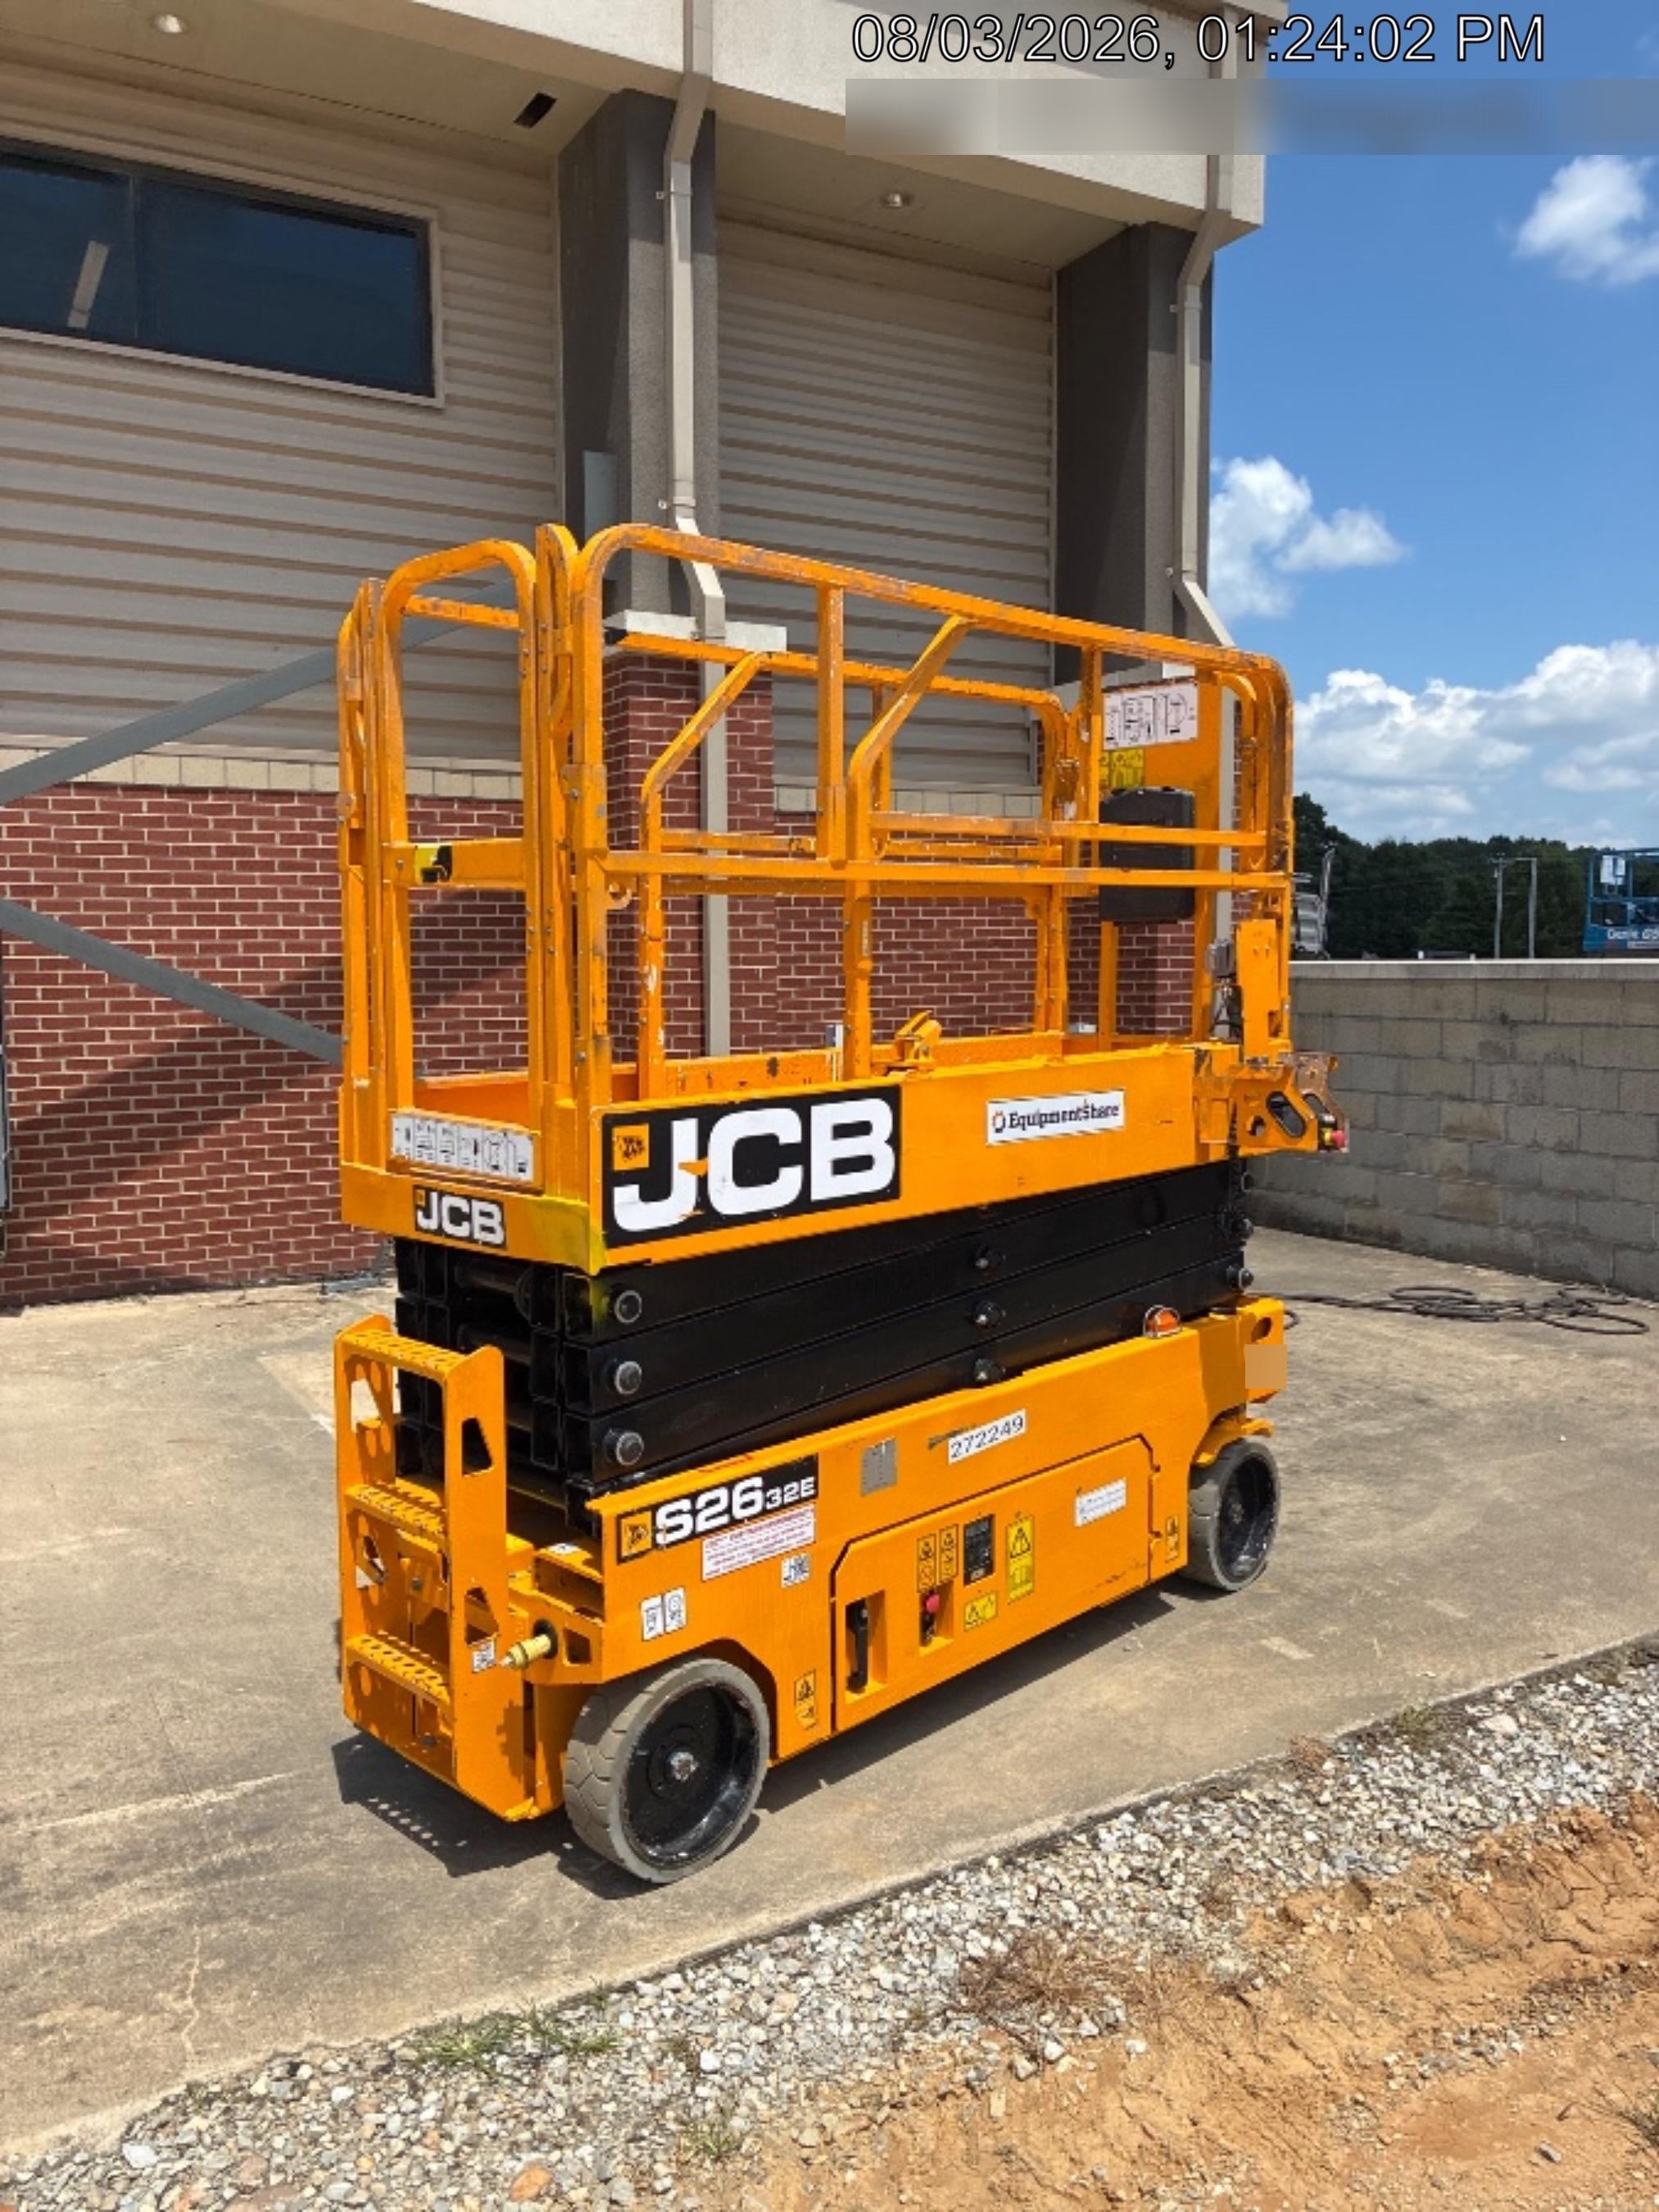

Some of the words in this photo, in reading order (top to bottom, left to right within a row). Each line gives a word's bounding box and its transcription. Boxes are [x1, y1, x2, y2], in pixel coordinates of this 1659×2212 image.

[1009, 1104, 1120, 1131] EquipmentShare
[612, 1097, 895, 1232] JCB
[417, 1191, 505, 1244] JCB
[950, 1415, 1023, 1458] 272249
[655, 1476, 764, 1545] S26
